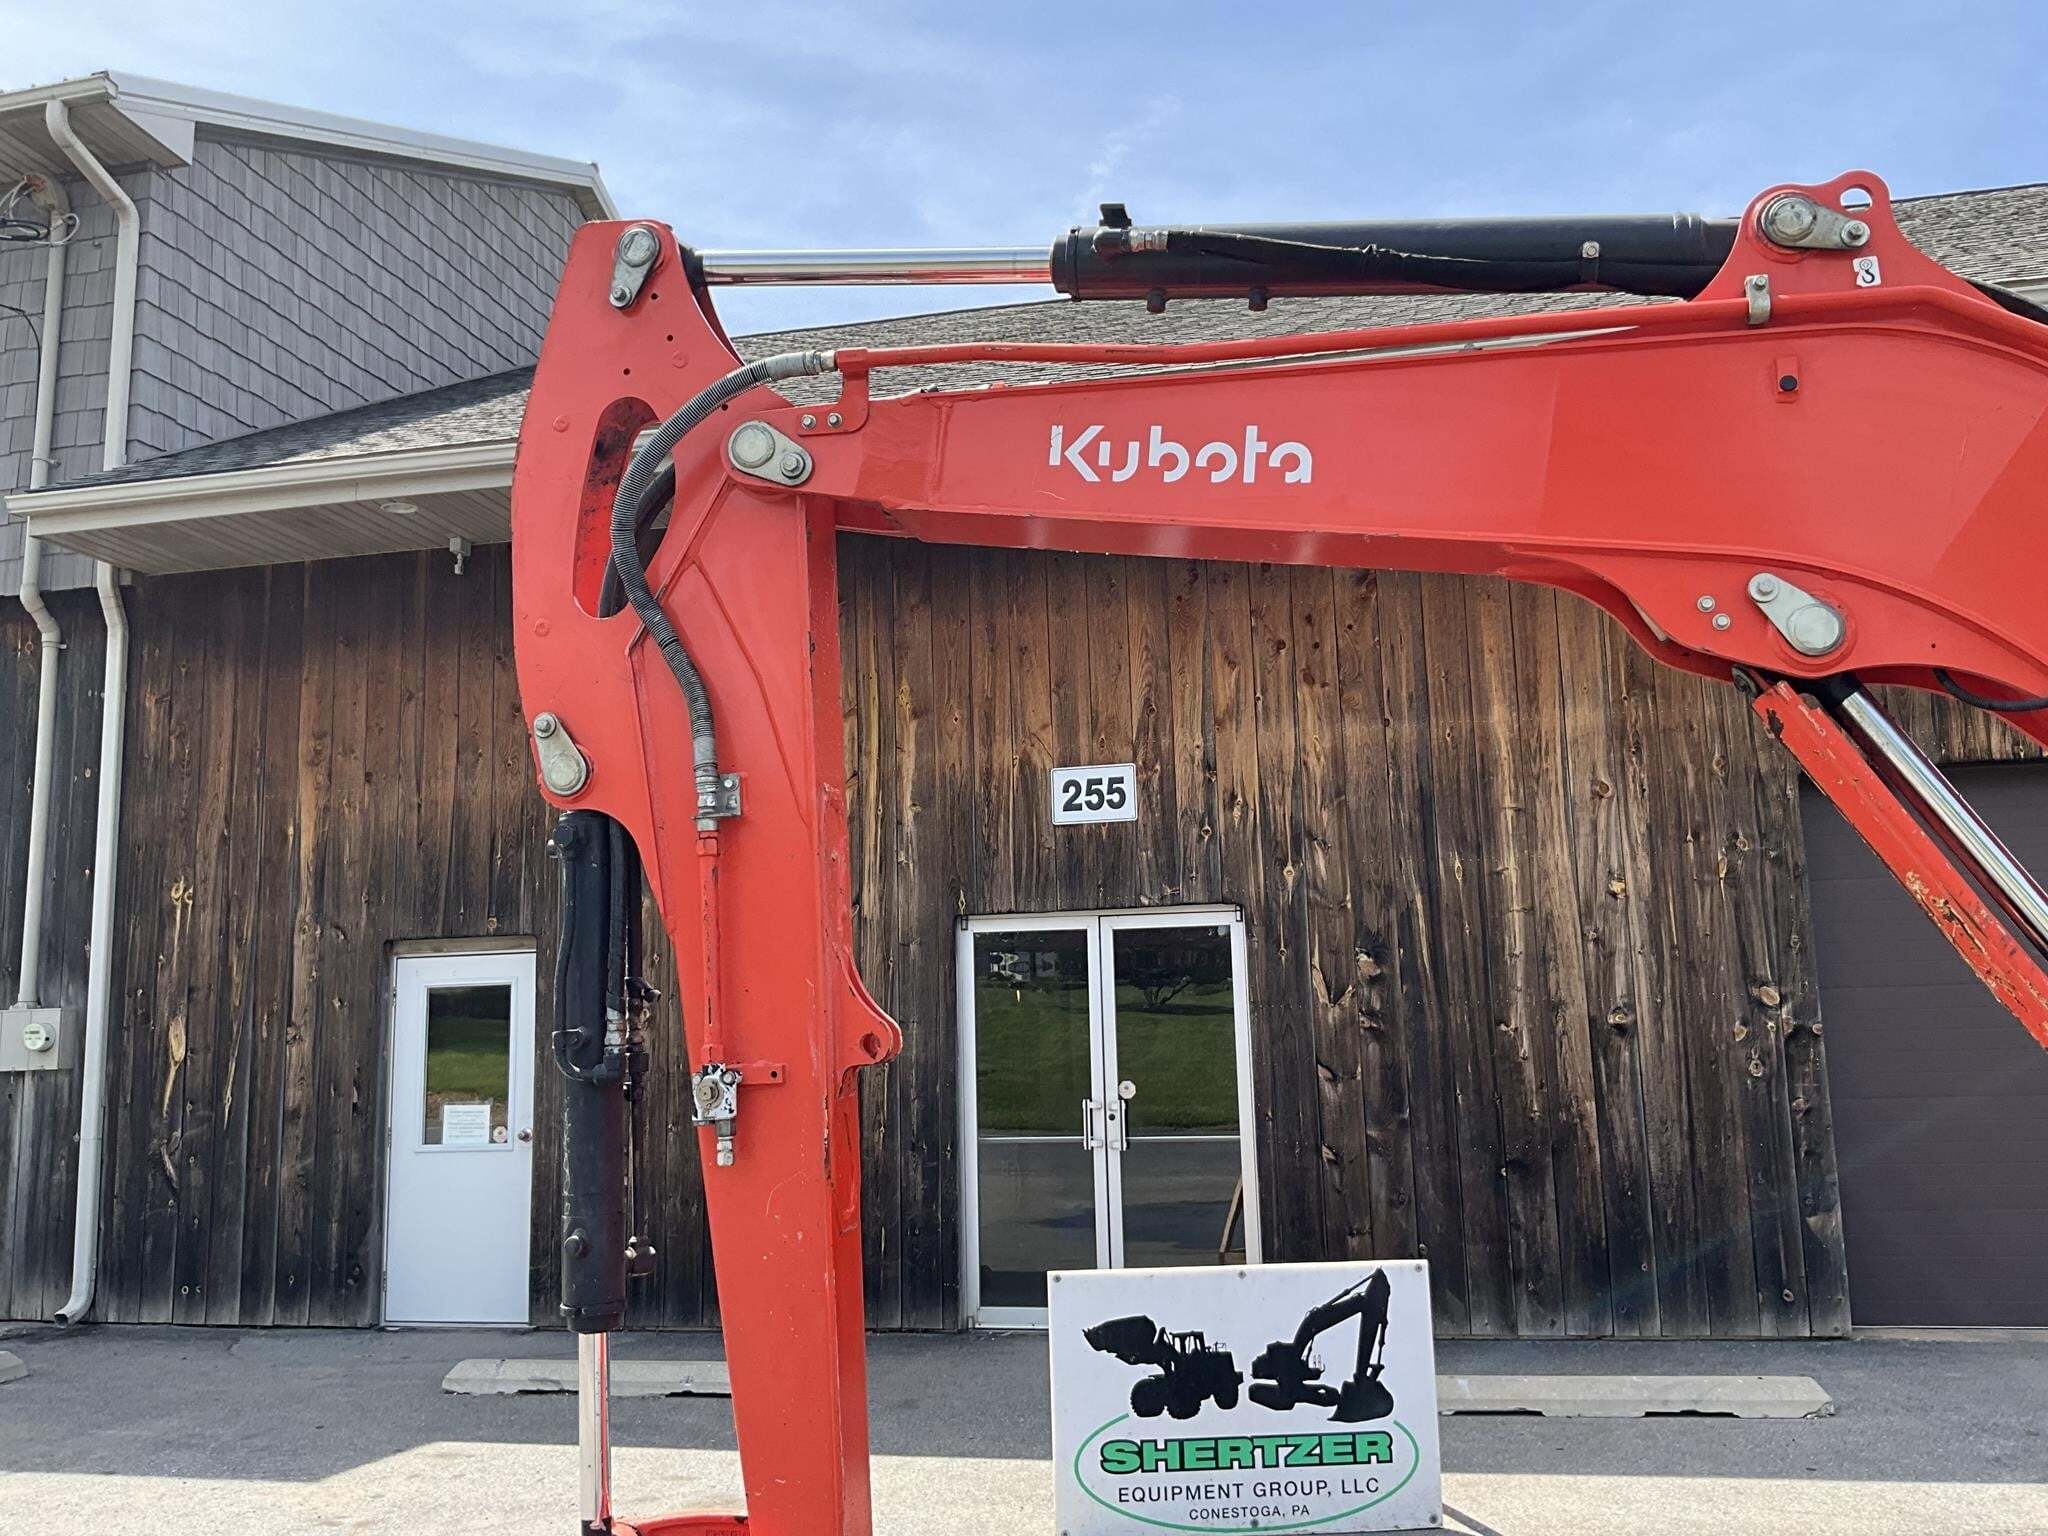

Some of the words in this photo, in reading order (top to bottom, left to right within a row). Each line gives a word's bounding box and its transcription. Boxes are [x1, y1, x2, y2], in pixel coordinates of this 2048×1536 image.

[1049, 425, 1313, 484] Kubota
[1062, 776, 1126, 812] 255
[1100, 1431, 1394, 1474] SHERTZER
[1118, 1483, 1245, 1503] EQUIPMENT
[1253, 1481, 1332, 1500] GROUP,
[1341, 1478, 1380, 1494] LLC
[1189, 1505, 1286, 1521] CONESTOGA,
[1291, 1504, 1310, 1516] PA
